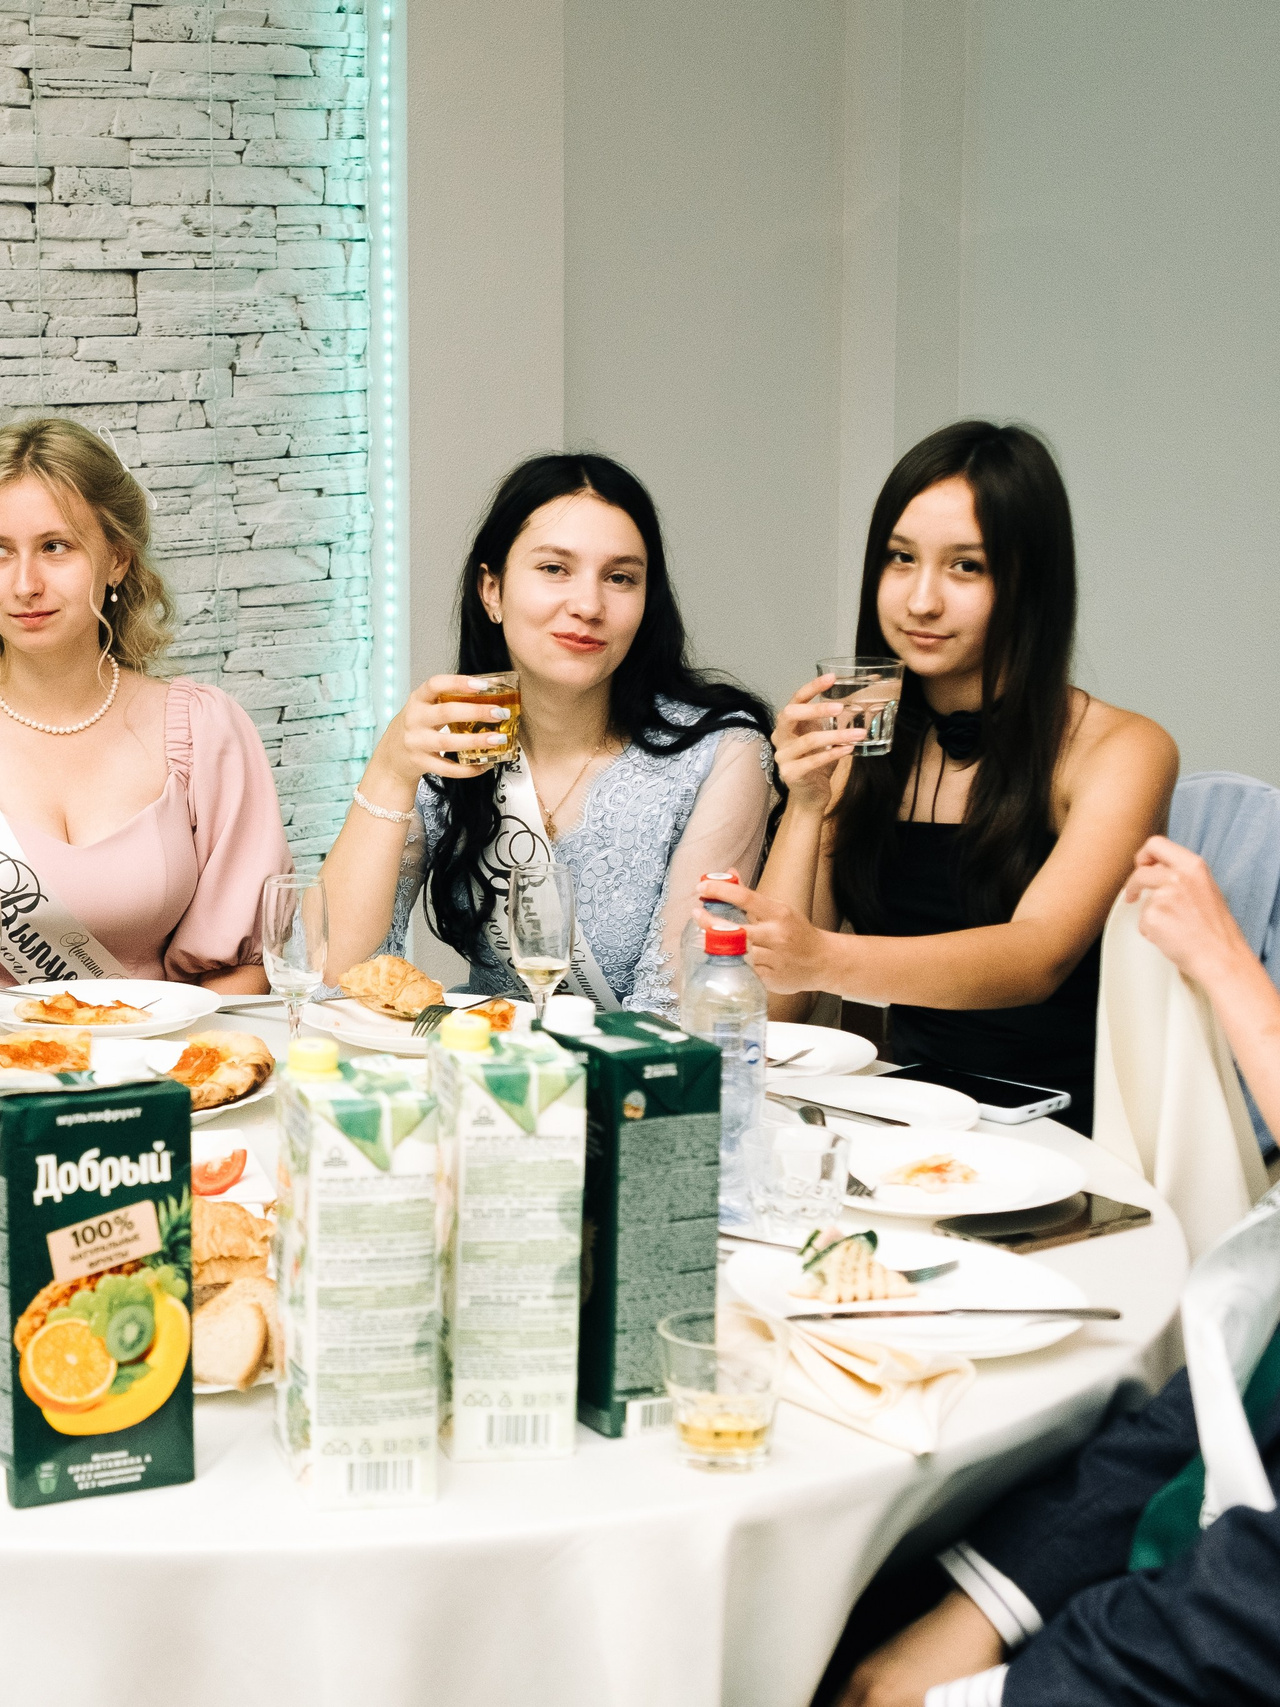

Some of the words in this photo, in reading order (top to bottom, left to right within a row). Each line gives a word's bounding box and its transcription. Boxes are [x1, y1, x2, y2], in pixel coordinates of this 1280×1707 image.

[55, 1107, 142, 1127] мультифрукт
[32, 1140, 173, 1206] Добрый
[71, 1212, 135, 1248] 100%
